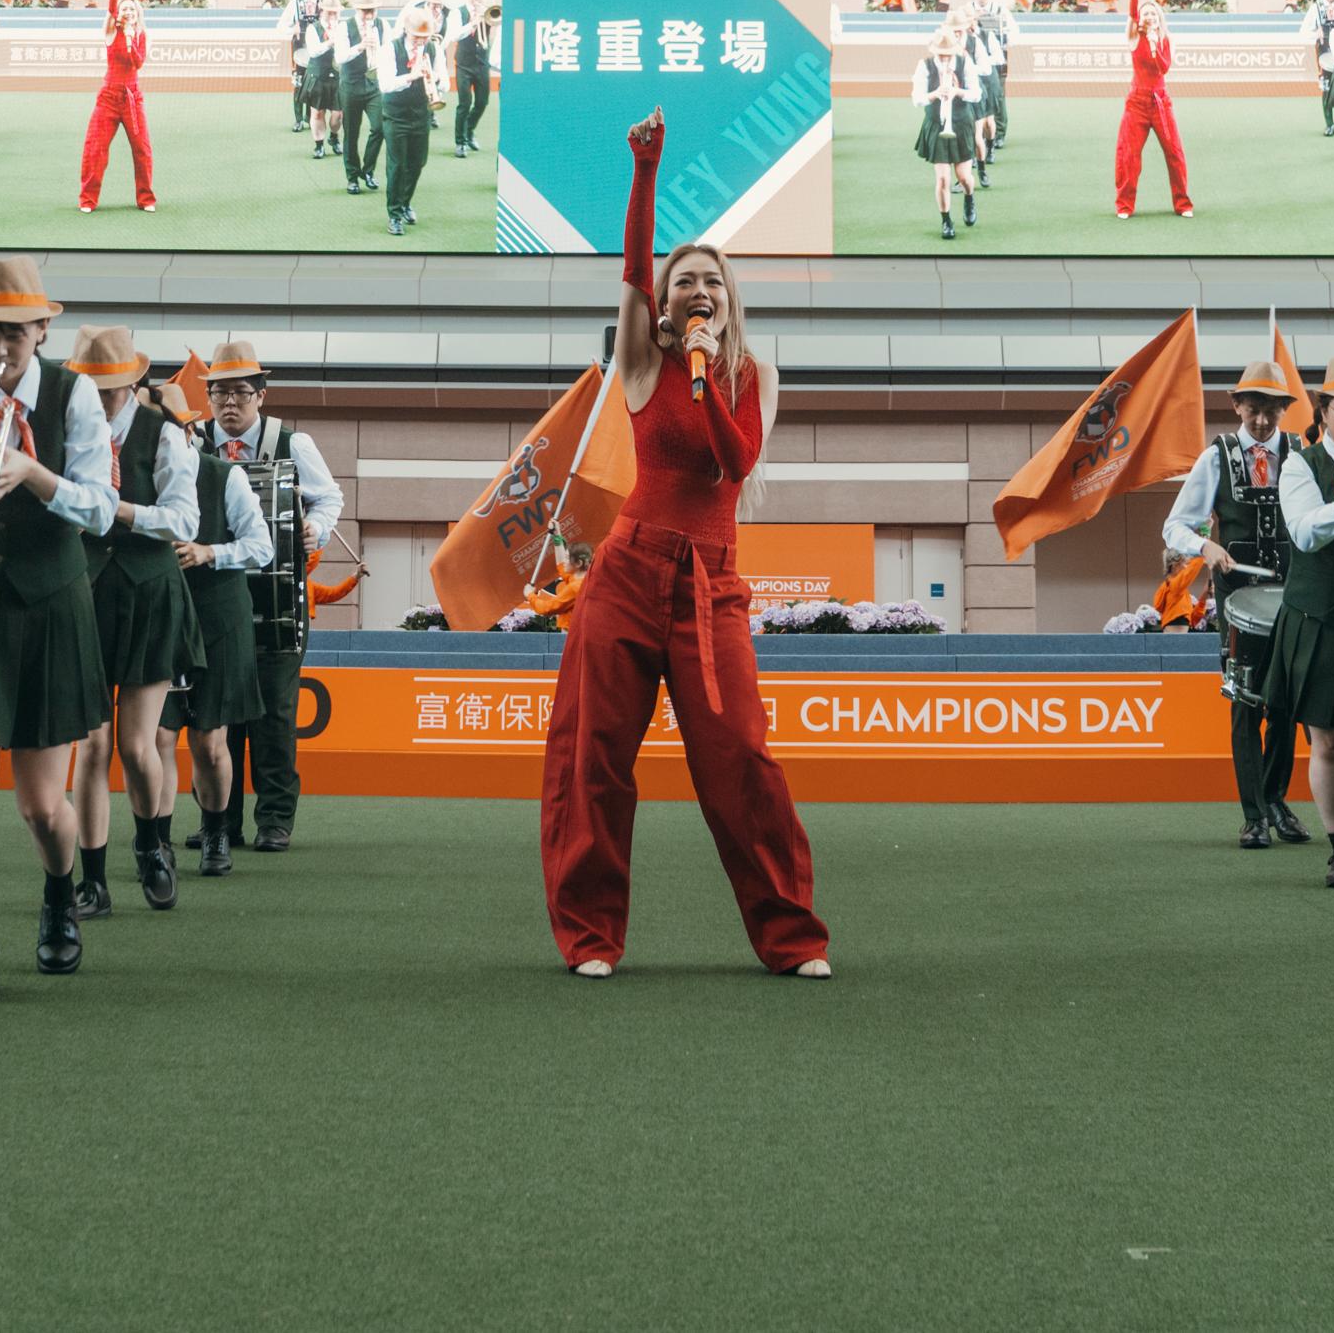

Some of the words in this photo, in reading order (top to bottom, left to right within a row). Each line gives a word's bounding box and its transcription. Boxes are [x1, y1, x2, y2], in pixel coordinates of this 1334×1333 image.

[150, 48, 246, 62] CHAMPIONS
[248, 48, 282, 61] DAY
[534, 19, 768, 74] 隆重登場
[1174, 52, 1271, 67] CHAMPIONS
[1274, 52, 1306, 66] DAY
[655, 151, 735, 248] OEY
[497, 488, 565, 549] FWD
[804, 581, 830, 593] DAY
[800, 696, 1068, 734] CHAMPIONS
[1080, 697, 1164, 734] DAY
